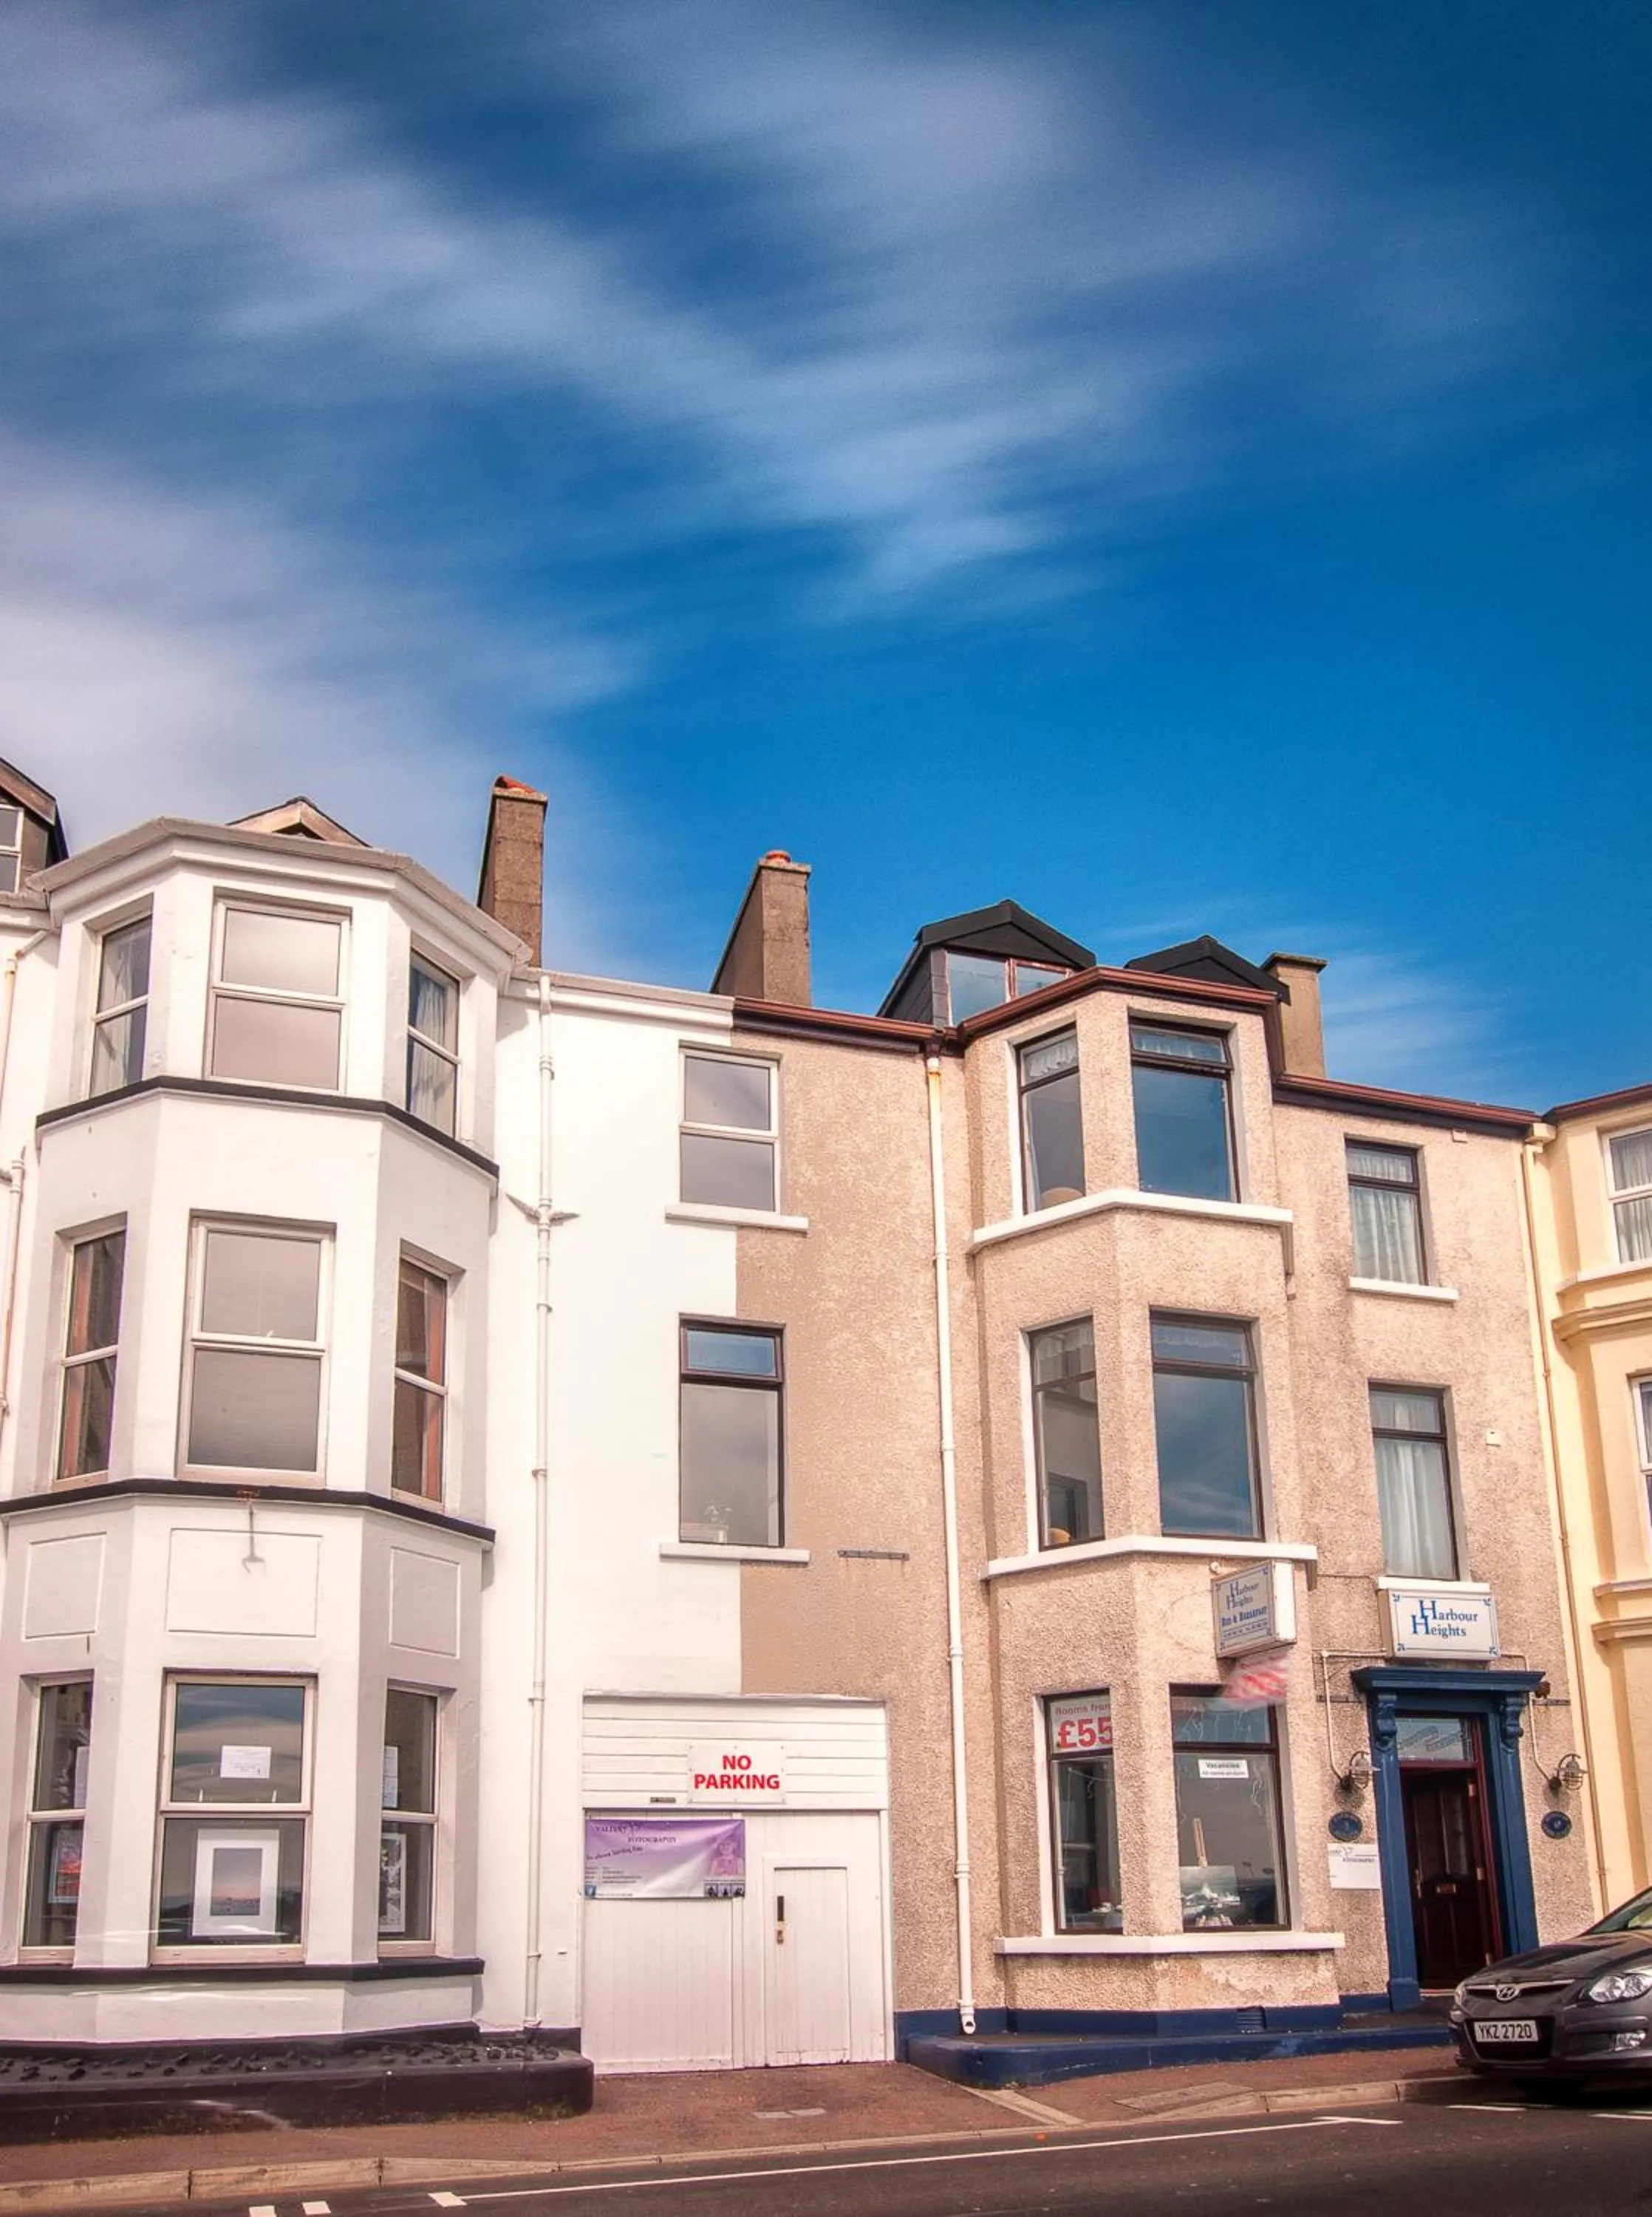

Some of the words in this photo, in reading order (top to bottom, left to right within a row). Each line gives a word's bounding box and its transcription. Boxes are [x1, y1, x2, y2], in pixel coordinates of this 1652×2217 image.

[1419, 1600, 1478, 1621] Harbour
[1411, 1615, 1467, 1639] Heights
[1055, 1706, 1088, 1715] Rooms
[1058, 1717, 1113, 1748] £55
[722, 1755, 751, 1771] NO
[694, 1774, 780, 1790] PARKING
[1479, 2024, 1500, 2040] YKZ
[1501, 2023, 1532, 2039] 2720
